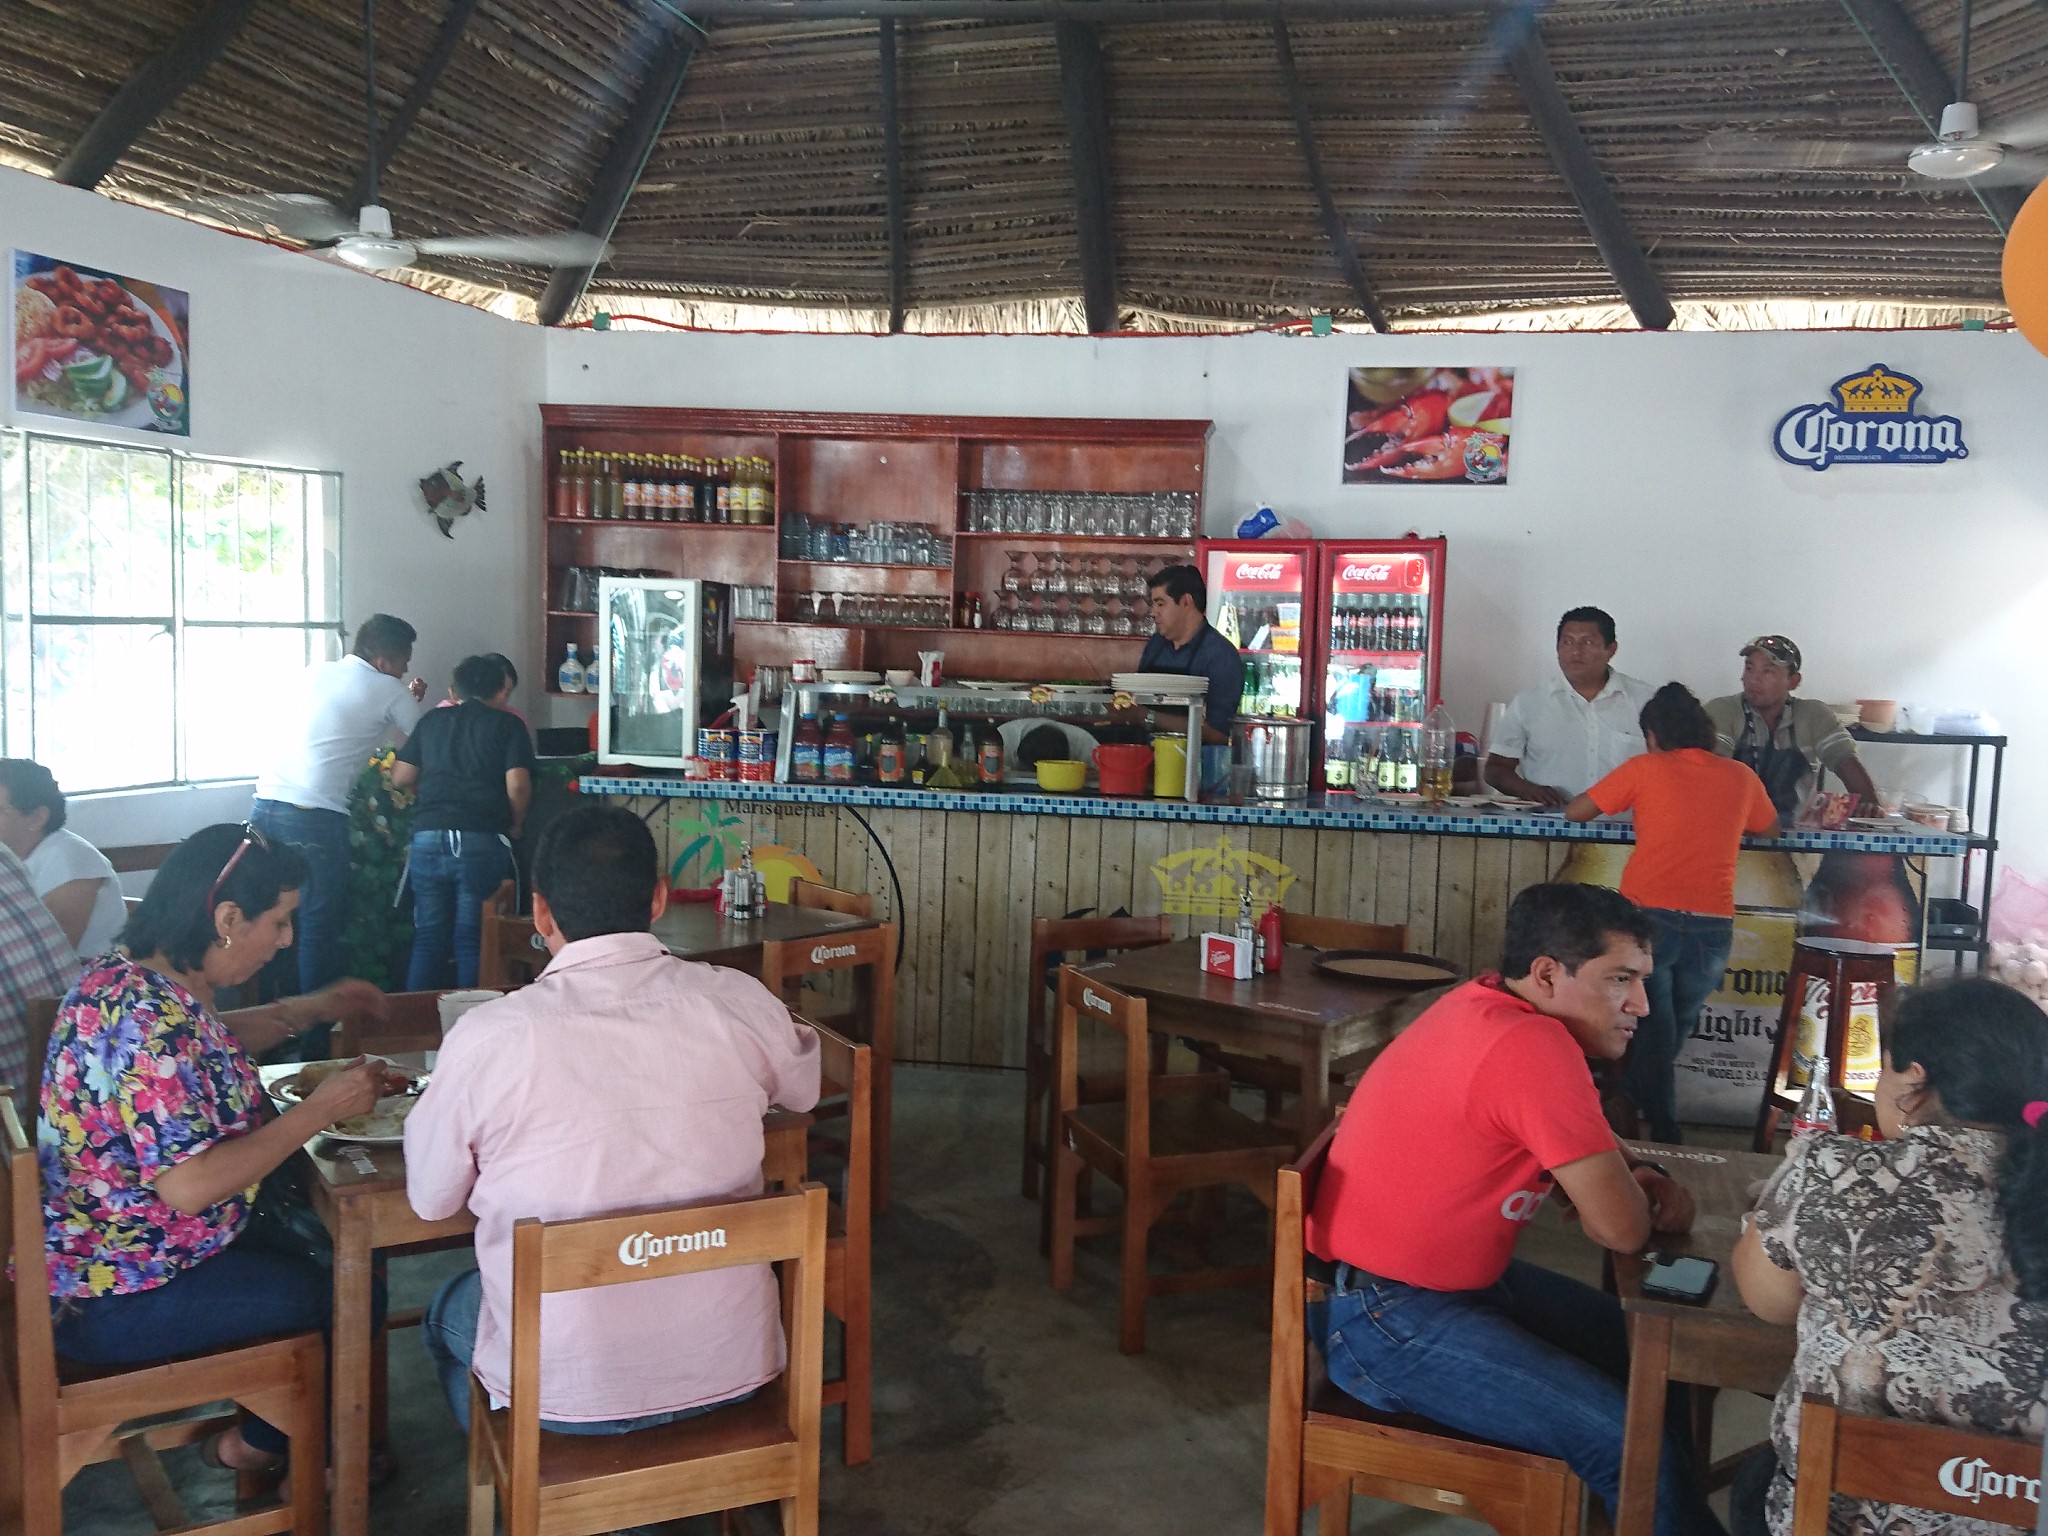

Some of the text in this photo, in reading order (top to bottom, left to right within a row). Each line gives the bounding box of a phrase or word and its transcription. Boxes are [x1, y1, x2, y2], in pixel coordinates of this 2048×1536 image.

[1779, 407, 1960, 465] Corona
[811, 944, 857, 965] Corona
[617, 1227, 728, 1268] Corona
